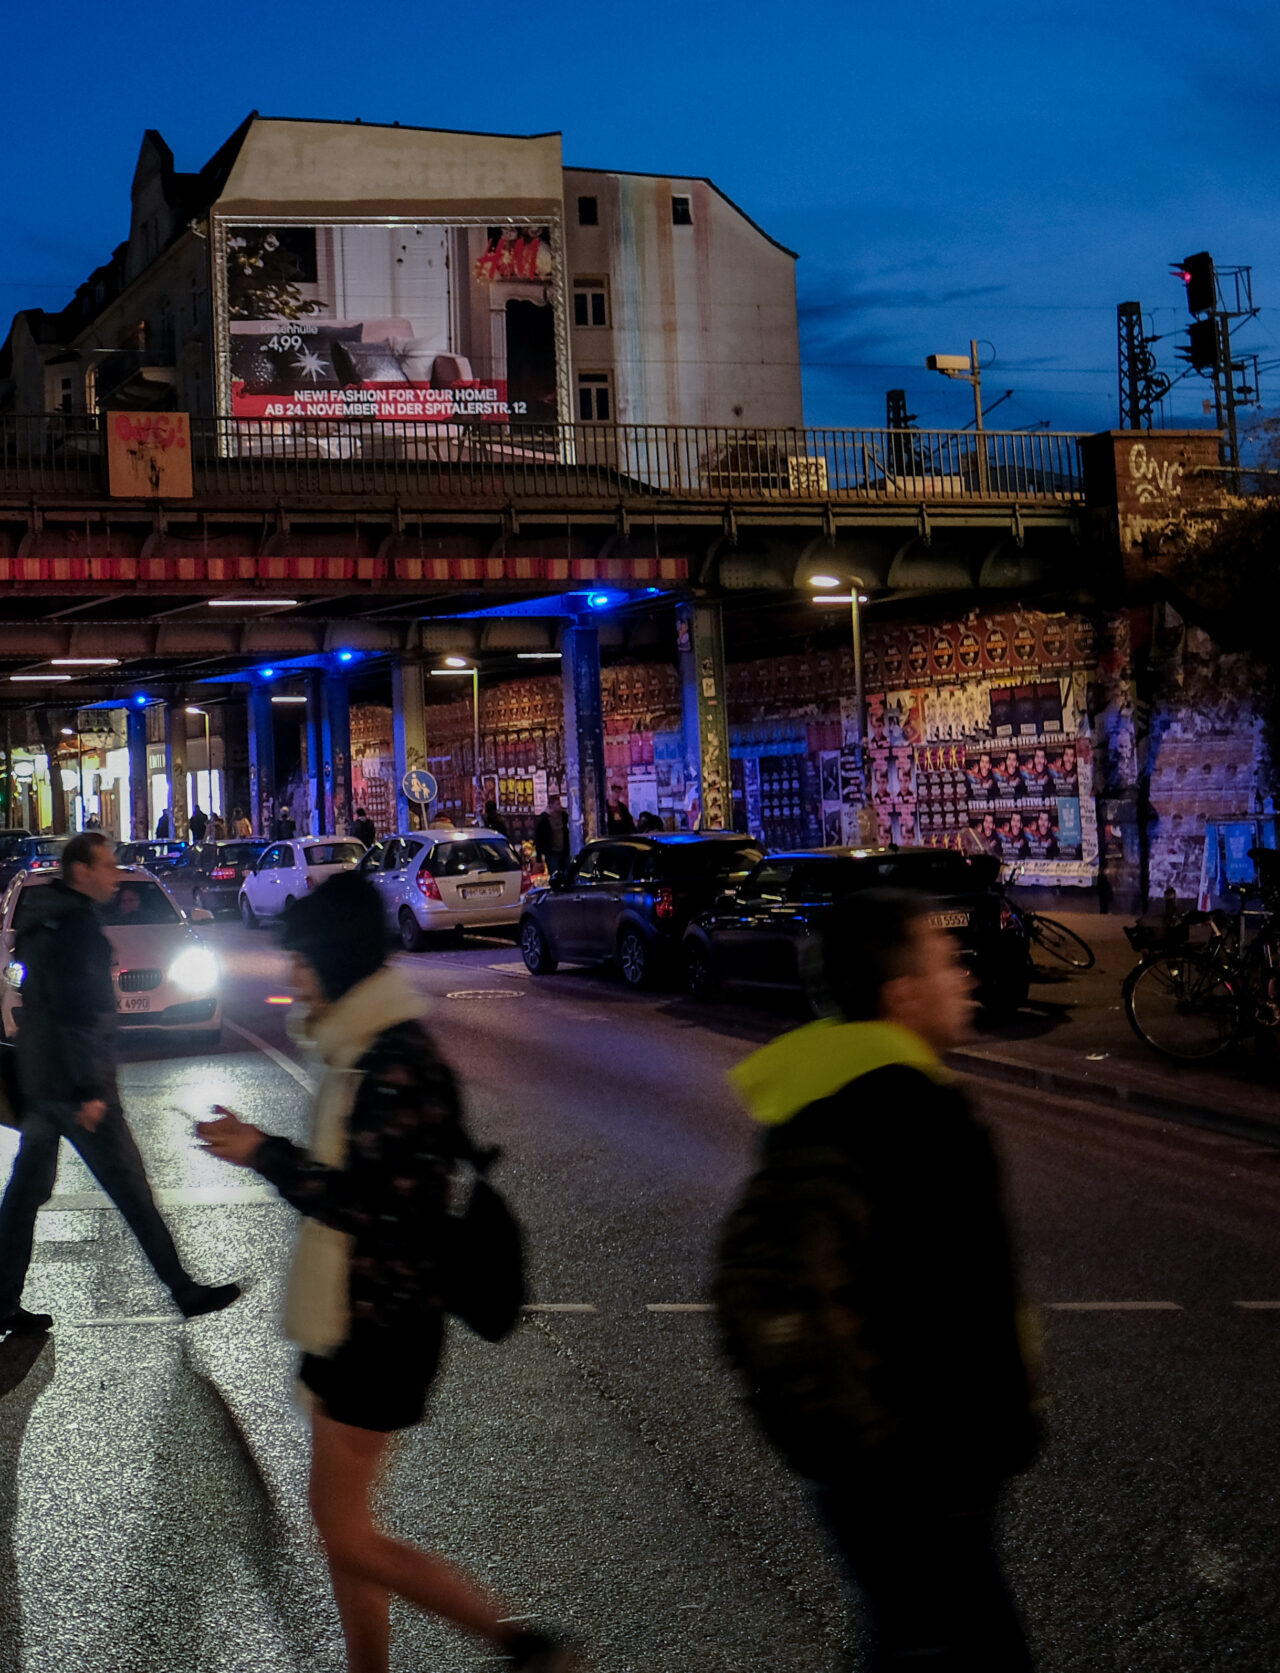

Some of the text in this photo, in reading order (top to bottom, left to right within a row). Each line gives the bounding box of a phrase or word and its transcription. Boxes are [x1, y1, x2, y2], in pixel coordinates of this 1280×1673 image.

[268, 335, 302, 353] 4,99
[293, 388, 498, 401] NEW! FASHION FOR YOUR HOME!
[264, 401, 528, 415] AB 24. NOVEMBER IN DER SPITALERSTR. 12
